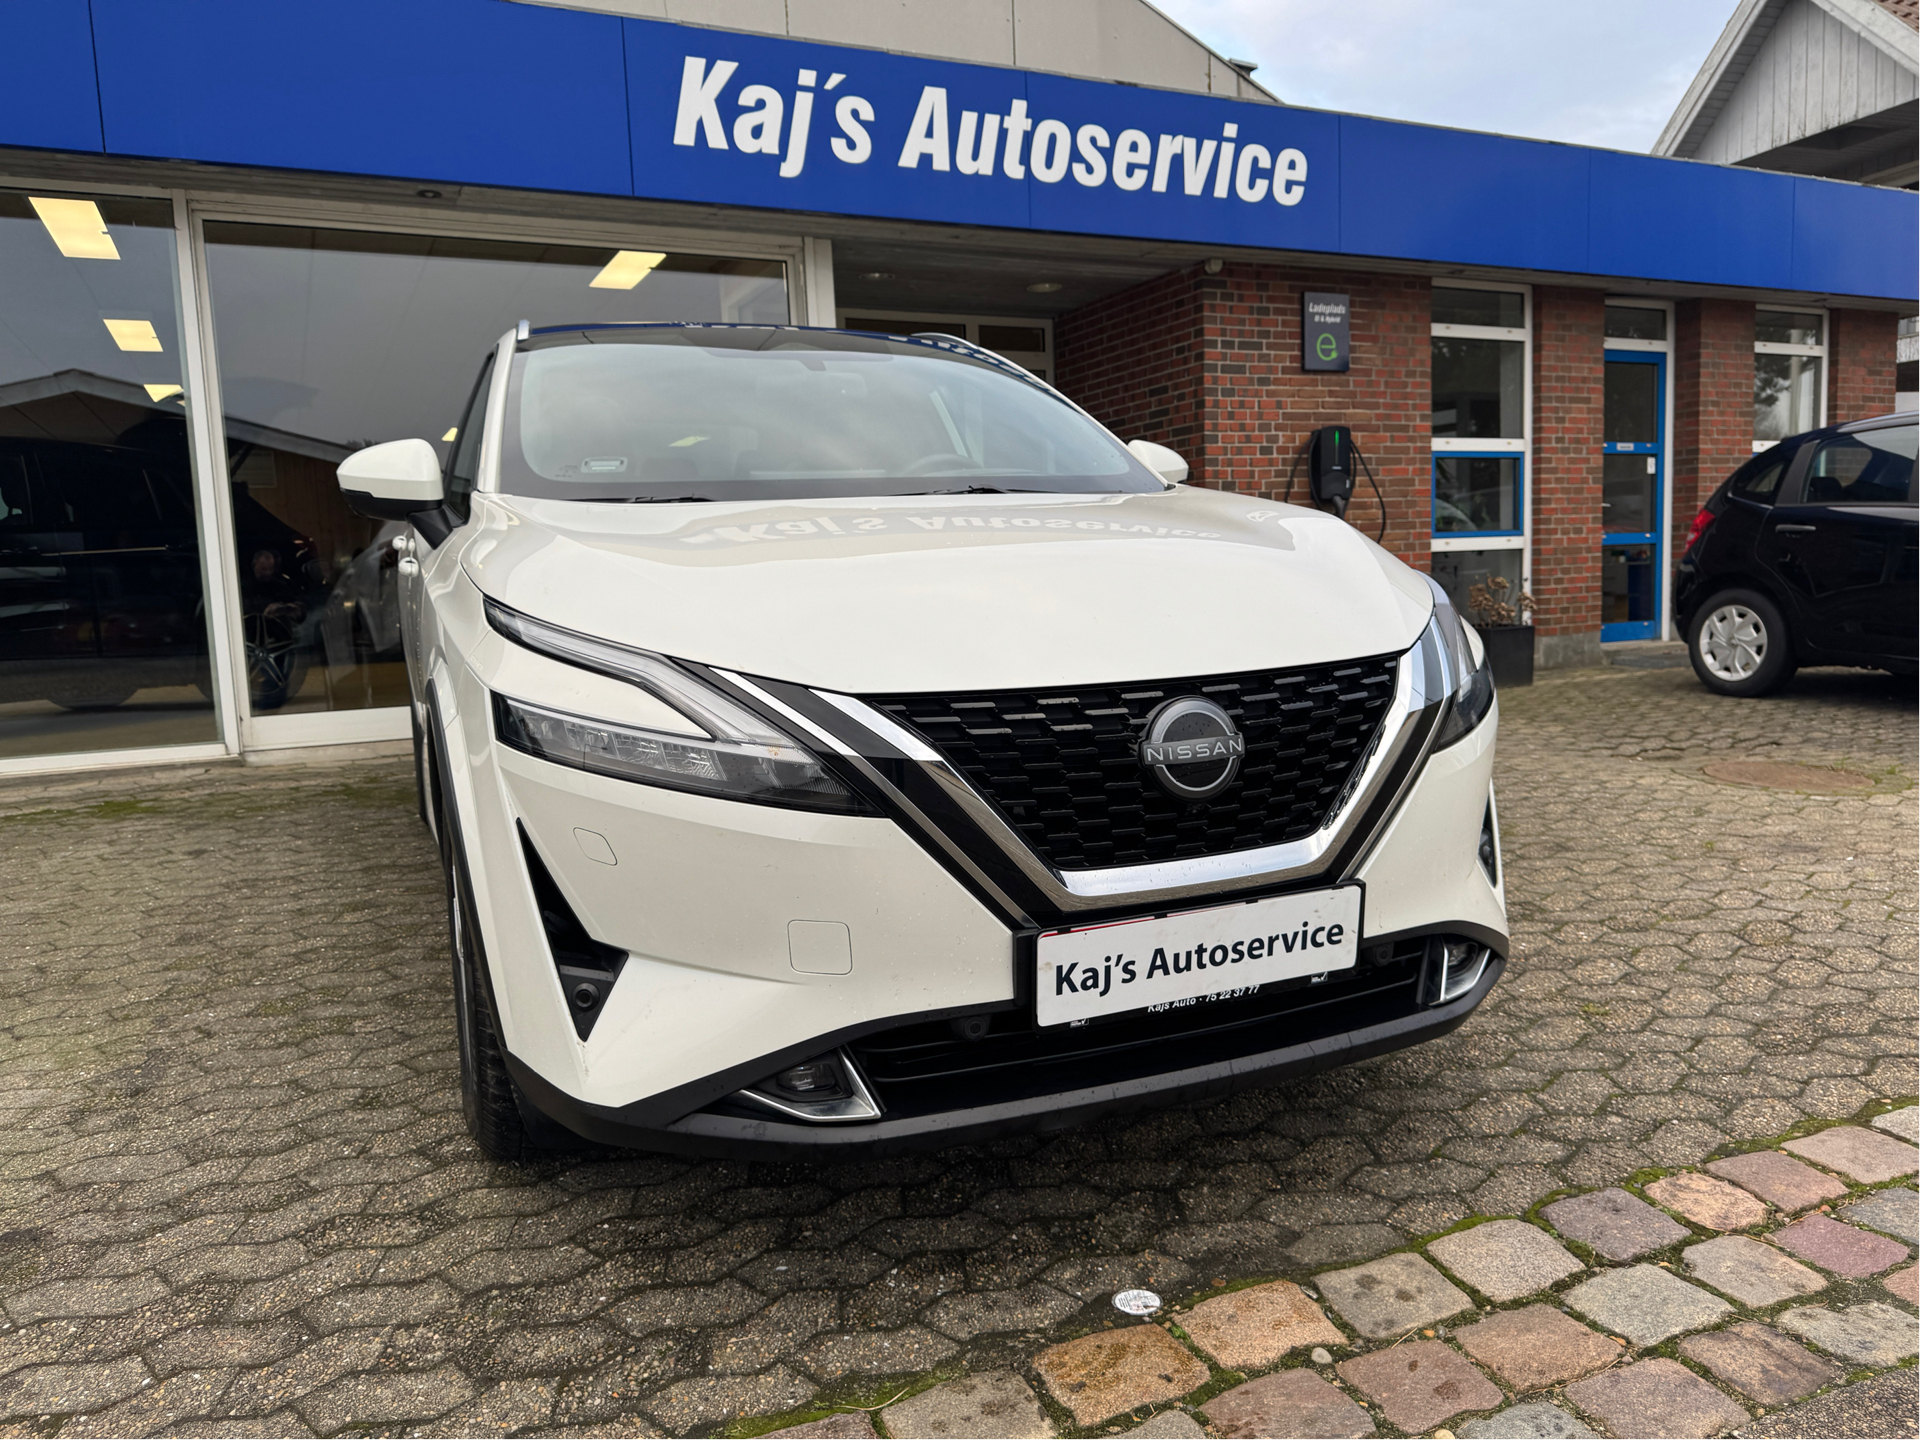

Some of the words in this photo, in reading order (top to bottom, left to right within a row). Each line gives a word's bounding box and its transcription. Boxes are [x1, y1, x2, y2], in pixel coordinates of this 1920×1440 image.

[897, 85, 1308, 206] Autoservice
[1147, 738, 1242, 761] NISSAN
[1055, 953, 1137, 997] Kaj's
[1146, 921, 1344, 980] Autoservice
[1172, 997, 1197, 1008] Auto
[1219, 989, 1231, 1000] 22
[1233, 986, 1246, 997] 37
[1248, 984, 1260, 995] 77
